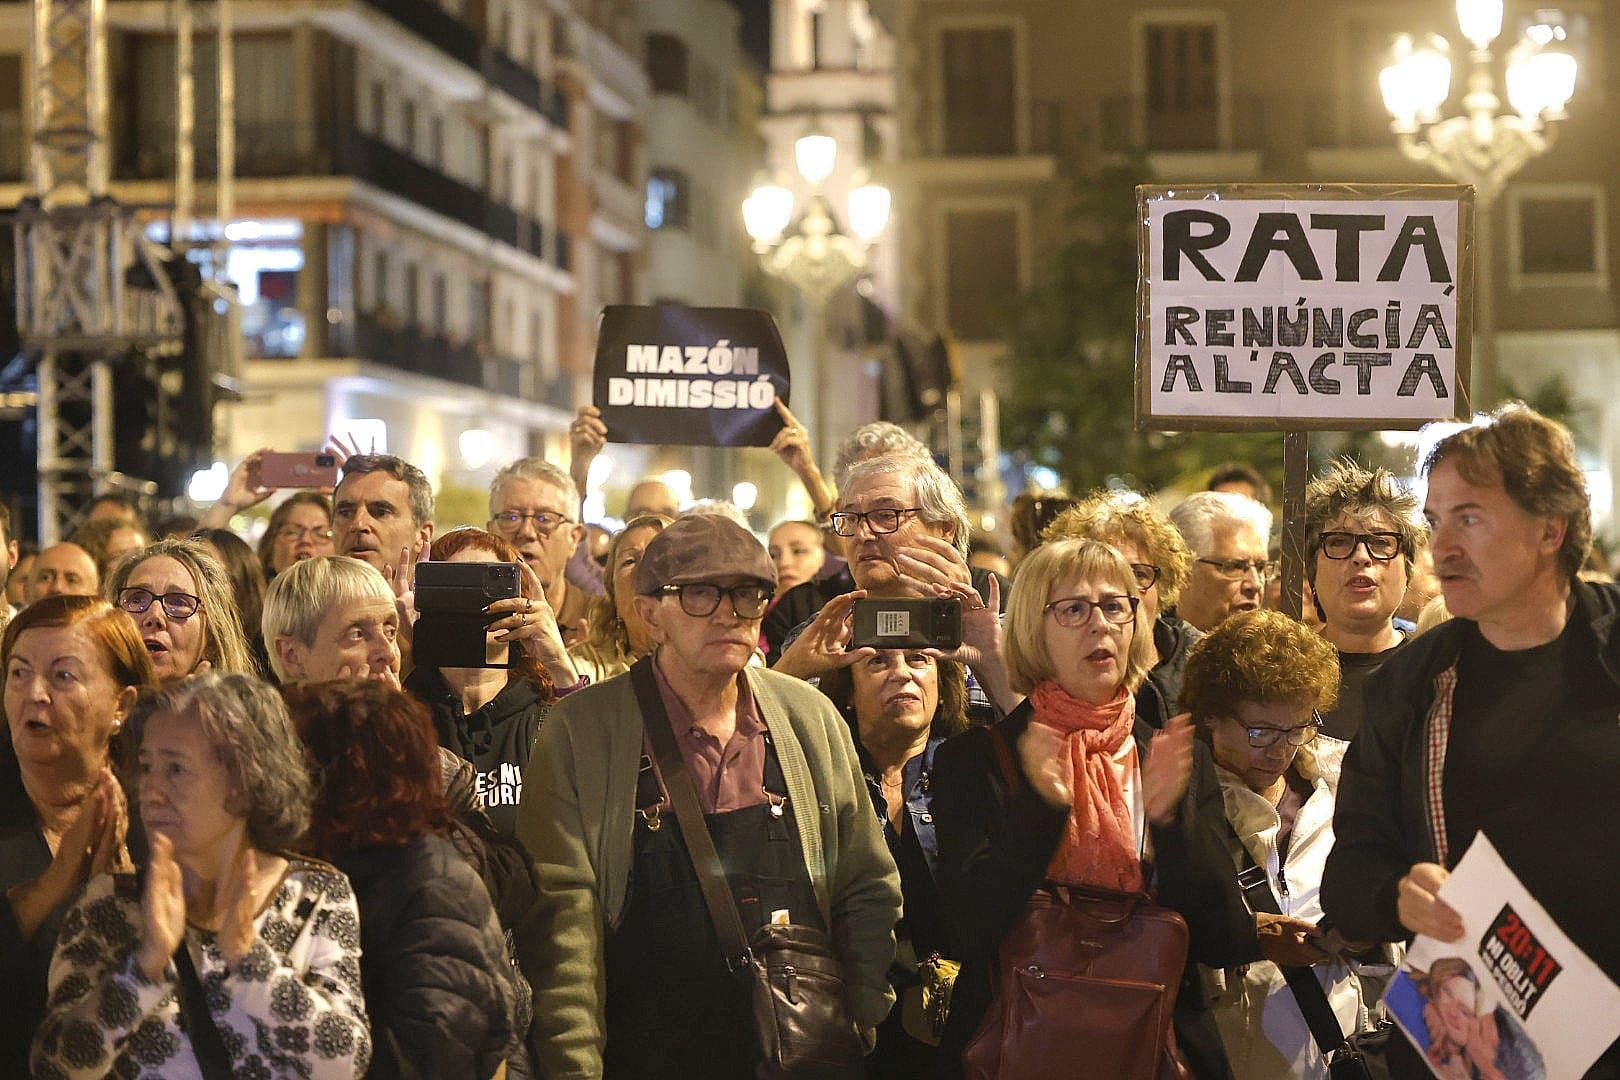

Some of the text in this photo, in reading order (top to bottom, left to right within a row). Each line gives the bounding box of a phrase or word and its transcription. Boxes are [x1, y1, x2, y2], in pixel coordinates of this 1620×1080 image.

[1162, 209, 1455, 296] RATA,
[626, 339, 758, 375] MAZÓN
[1161, 350, 1449, 398] A L'ACTA
[608, 374, 775, 409] DIMISSIÓ
[1497, 913, 1555, 985] 20:11
[1500, 952, 1537, 1000] OBLIT
